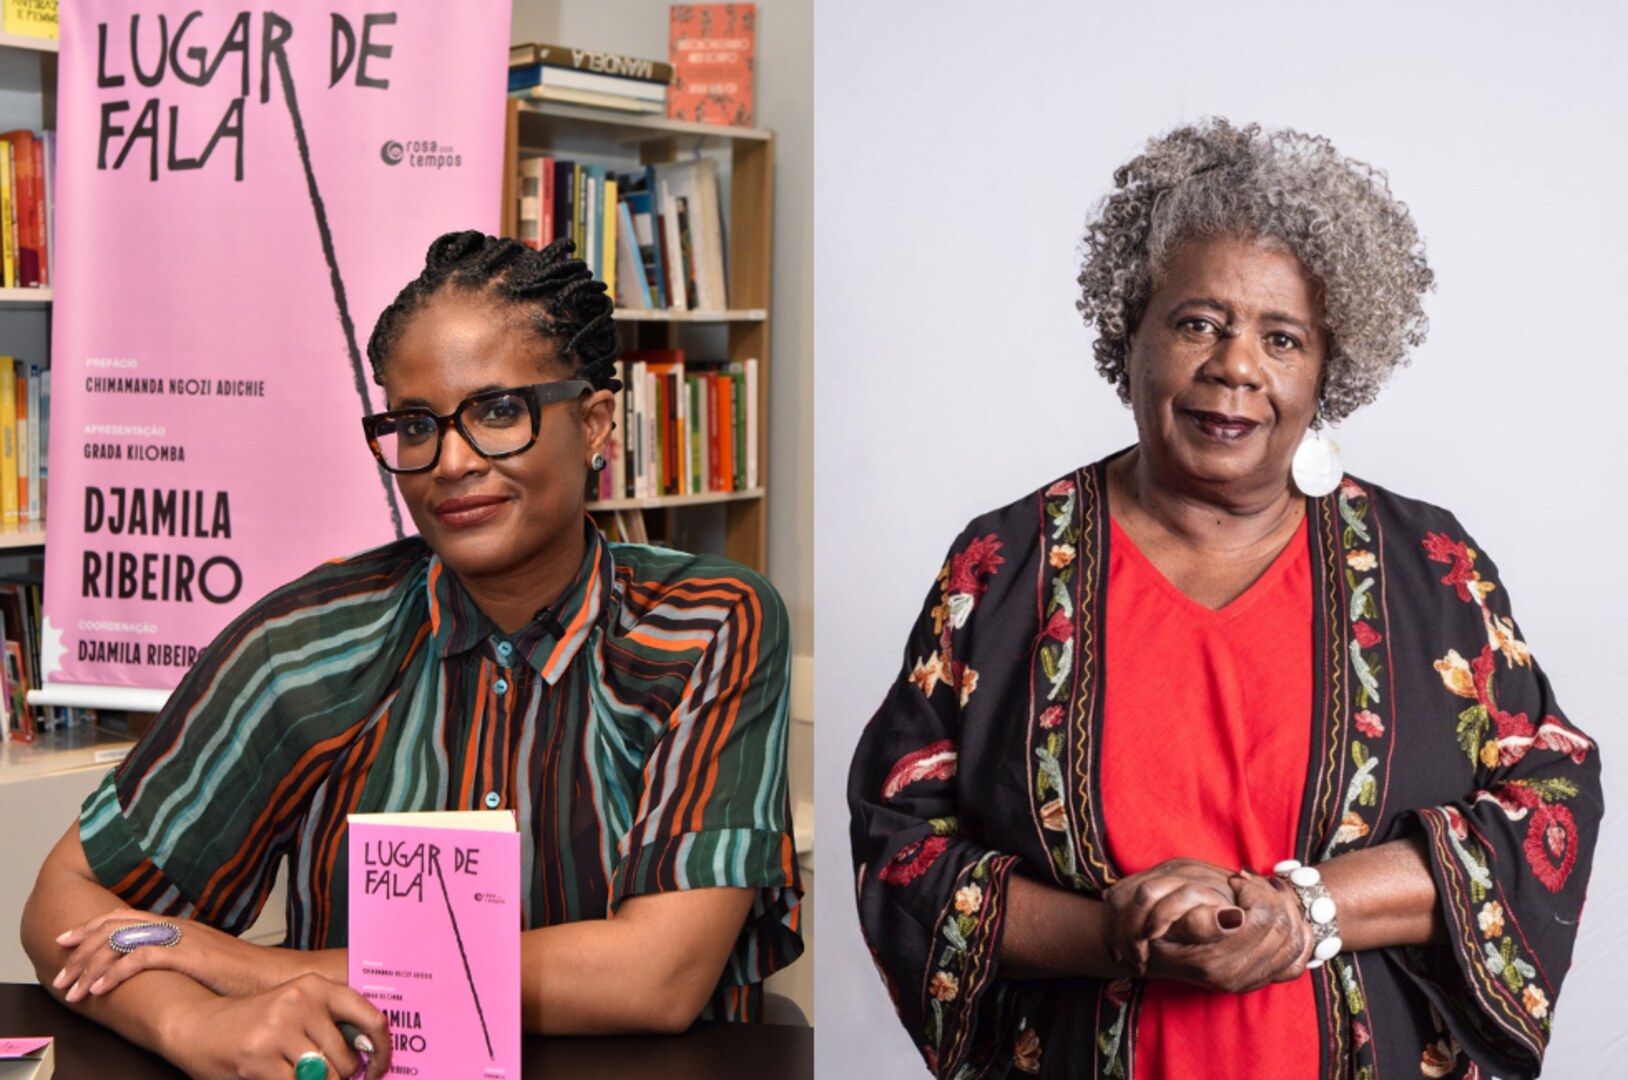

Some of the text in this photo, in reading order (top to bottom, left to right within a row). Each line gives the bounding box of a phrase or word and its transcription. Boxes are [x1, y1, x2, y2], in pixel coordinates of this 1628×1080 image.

[98, 10, 397, 104] LUGAR DE
[572, 48, 653, 79] MANDELA
[98, 97, 246, 182] FALA
[406, 140, 438, 153] rosa
[410, 154, 462, 170] tempos
[86, 358, 138, 369] PREFÁCIO
[85, 377, 265, 396] CHIMAMANDA NGOZI ADICHIE
[84, 424, 166, 437] APRESENTAÇÃO
[84, 443, 185, 461] GRADA KILOMBA
[84, 486, 231, 539] DJAMILA
[82, 551, 243, 604] RIBEIRO
[78, 620, 158, 634] COORDENAÇÃO
[78, 640, 141, 664] DJAMILA
[365, 840, 479, 876] LUGAR DE
[365, 870, 422, 902] FALA
